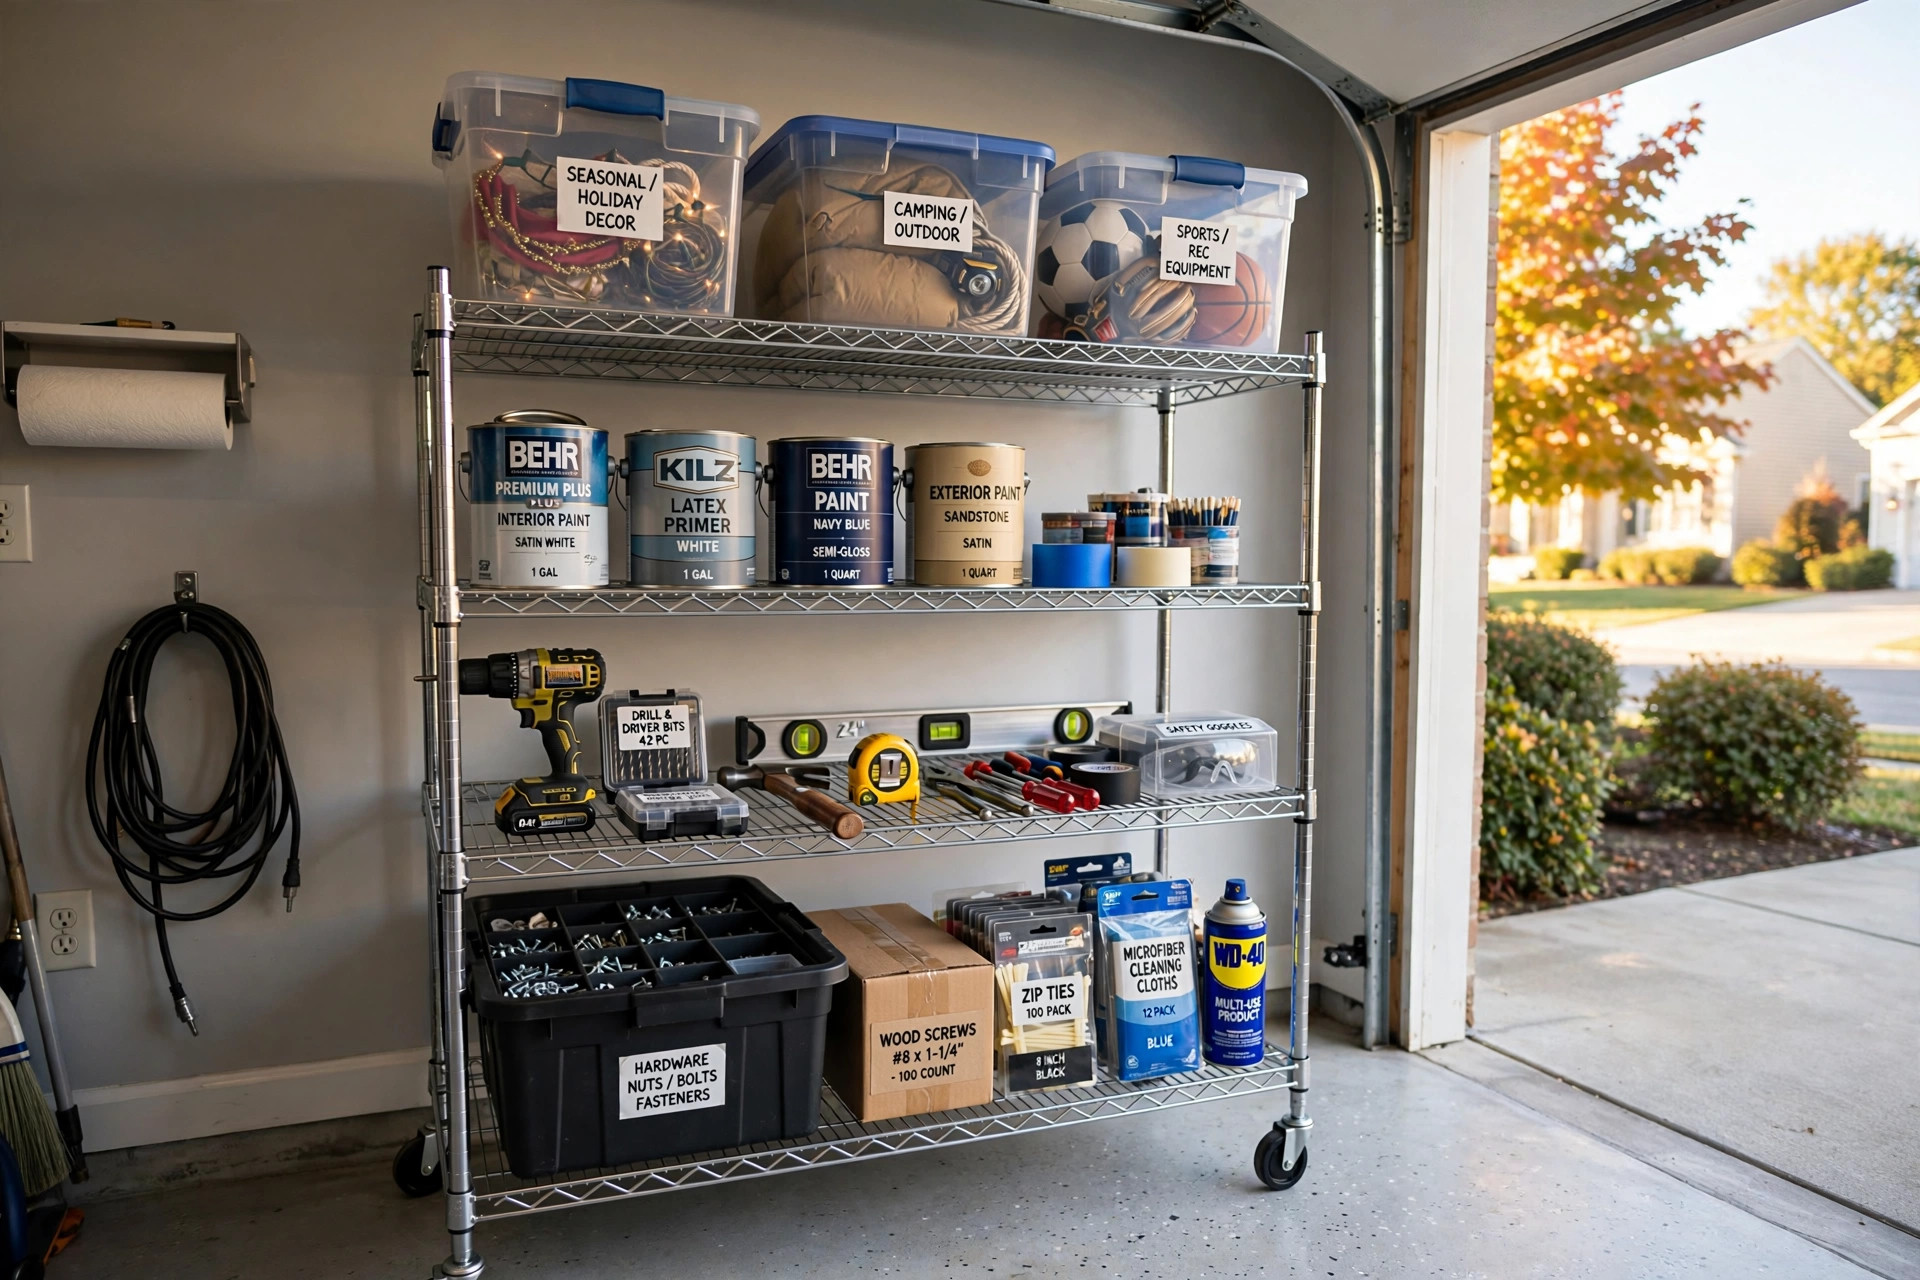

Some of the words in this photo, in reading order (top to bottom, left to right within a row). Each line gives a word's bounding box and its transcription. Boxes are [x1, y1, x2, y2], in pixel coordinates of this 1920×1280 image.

[567, 166, 646, 189] SEASONAL
[578, 189, 643, 210] HOLIDAY
[894, 201, 956, 222] CAMPING
[585, 211, 636, 231] DECOR
[894, 224, 960, 243] OUTDOOR
[1177, 224, 1220, 242] SPORTS
[1189, 246, 1210, 259] REC
[1165, 260, 1231, 279] EQUIPMENT
[509, 440, 579, 471] BEHR
[660, 458, 735, 482] KILZ
[811, 453, 872, 481] BEHR
[495, 481, 558, 497] PREMIUM
[563, 483, 591, 498] PLUS
[930, 485, 990, 500] EXTERIOR
[994, 486, 1021, 501] PAINT
[671, 498, 727, 514] LATEX
[815, 491, 870, 511] PAINT
[498, 513, 554, 527] INTERIOR
[558, 513, 590, 527] PAINT
[944, 510, 1009, 523] SANDSTONE
[664, 517, 731, 533] PRIMER
[813, 519, 842, 531] NAVY
[845, 519, 871, 531] BLUE
[515, 537, 542, 548] SATIN
[545, 537, 575, 548] WHITE
[676, 540, 719, 553] WHITE
[963, 537, 992, 549] SATIN
[812, 546, 871, 558] SEMI-GLOSS
[532, 568, 536, 577] 1
[539, 567, 558, 577] GAL
[683, 569, 688, 580] 1
[691, 569, 714, 580] GAL
[824, 569, 828, 579] 1
[831, 569, 860, 580] QUART
[962, 569, 966, 578] 1
[968, 568, 997, 578] QUART
[632, 710, 662, 721] DRILL
[664, 709, 673, 720] &
[622, 722, 661, 734] DRIVER
[663, 720, 686, 732] BITS
[1206, 722, 1252, 731] GOGGLES
[639, 735, 653, 746] 42
[655, 734, 669, 745] PC
[1123, 941, 1185, 961] MICROFIBER
[1129, 959, 1182, 977] CLEANING
[1137, 976, 1178, 993] CLOTHS
[1022, 987, 1043, 1004] ZIP
[1046, 983, 1075, 1000] TIES
[1215, 996, 1261, 1009] MULTI-USE
[1026, 1007, 1044, 1018] 100
[1047, 1004, 1072, 1017] PACK
[1143, 1008, 1152, 1018] 12
[1154, 1005, 1176, 1017] PACK
[1218, 1008, 1260, 1022] PRODUCT
[880, 1029, 921, 1048] WOOD
[925, 1022, 977, 1042] SCREWS
[1147, 1034, 1173, 1049] BLUE
[893, 1050, 910, 1065] #8
[926, 1042, 964, 1061] 1-1/4"
[1036, 1056, 1042, 1066] 8
[1044, 1053, 1065, 1066] INCH
[635, 1052, 709, 1075] HARDWARE
[899, 1069, 917, 1083] 100
[920, 1063, 955, 1079] COUNT
[1036, 1068, 1066, 1081] BLACK
[627, 1076, 663, 1094] NUTS
[666, 1074, 674, 1090] /
[677, 1069, 717, 1087] BOLTS
[636, 1088, 710, 1111] FASTENERS
